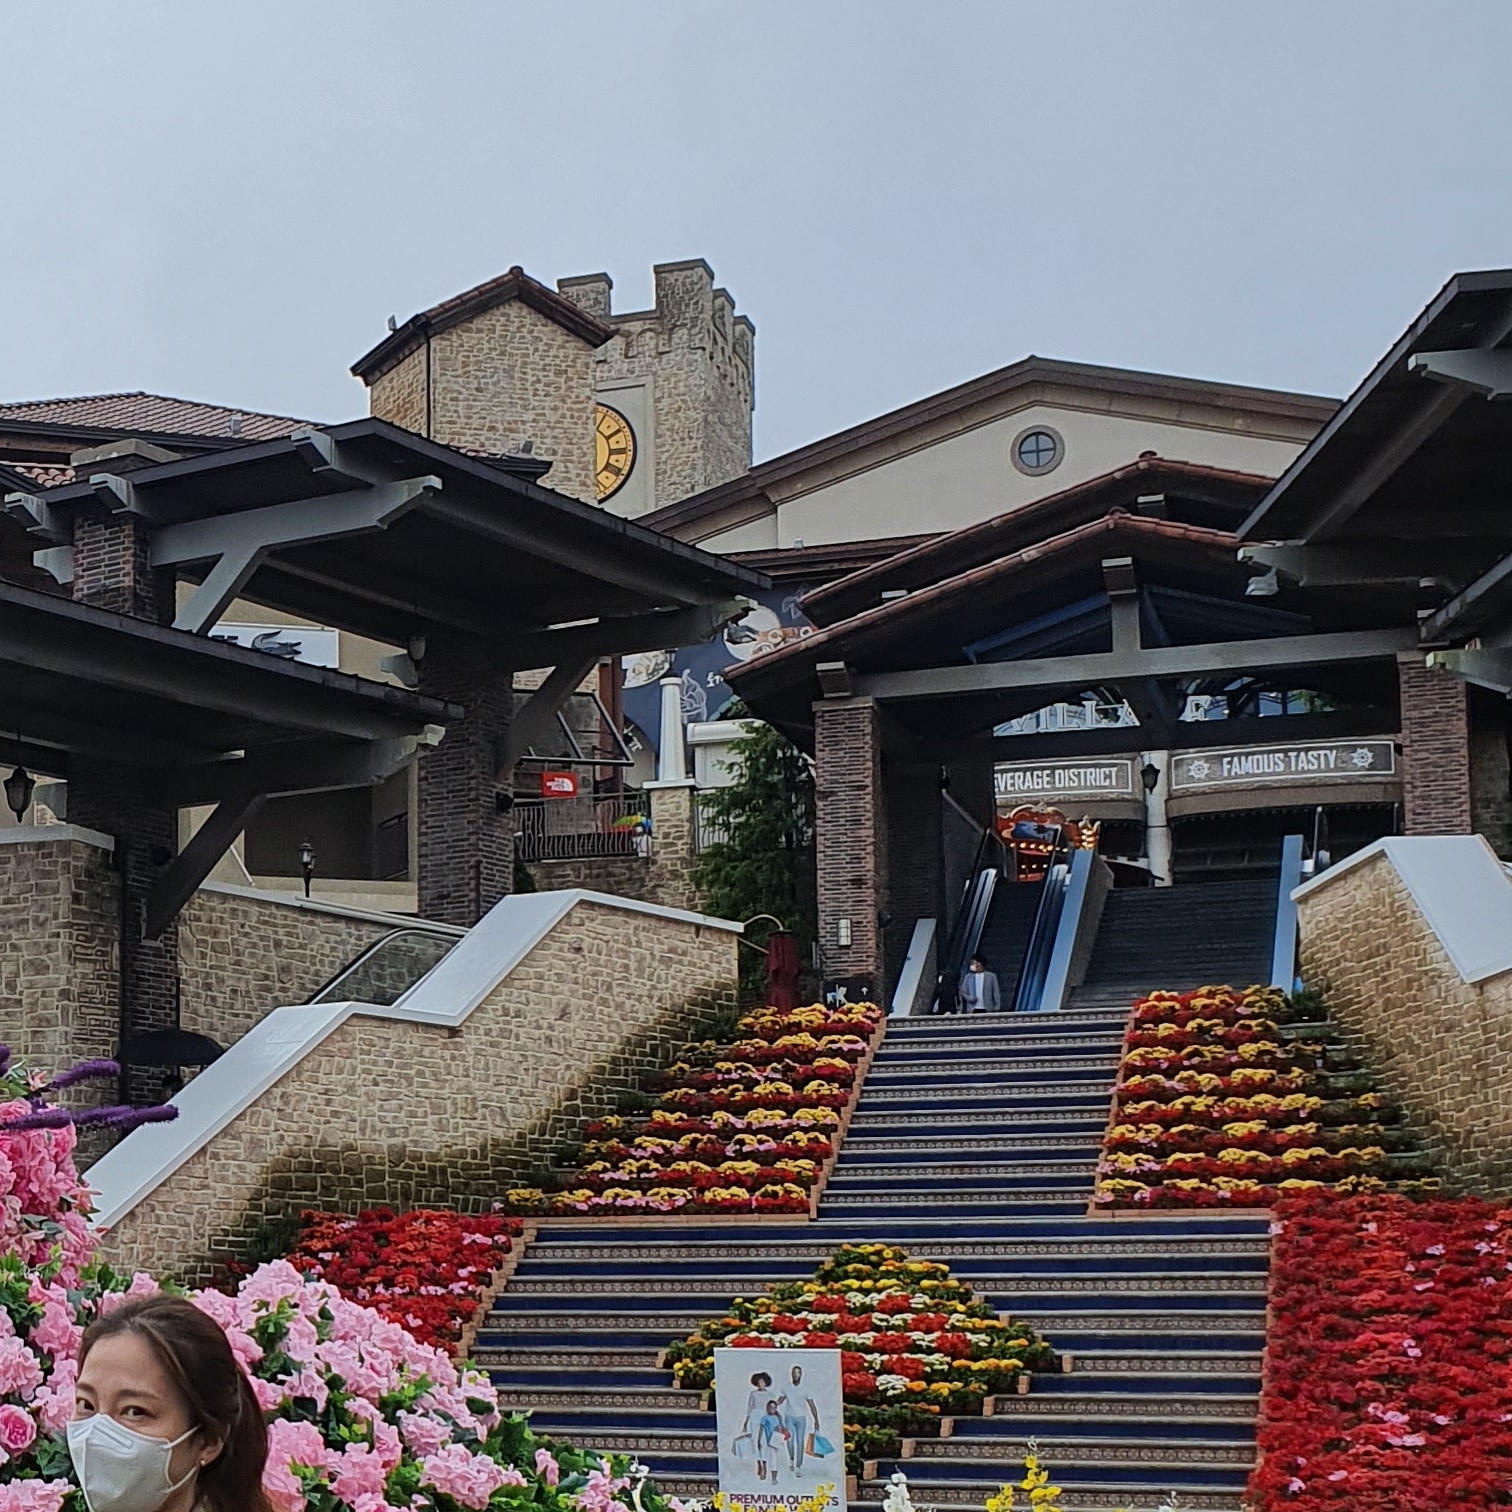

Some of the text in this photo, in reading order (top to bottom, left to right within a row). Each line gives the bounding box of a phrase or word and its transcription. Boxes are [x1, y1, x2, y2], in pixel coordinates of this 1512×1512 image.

[1222, 749, 1337, 777] FAMOUS TASTY
[1055, 767, 1117, 788] DISTRICT
[729, 1493, 839, 1506] PREMIUM OUTTS
